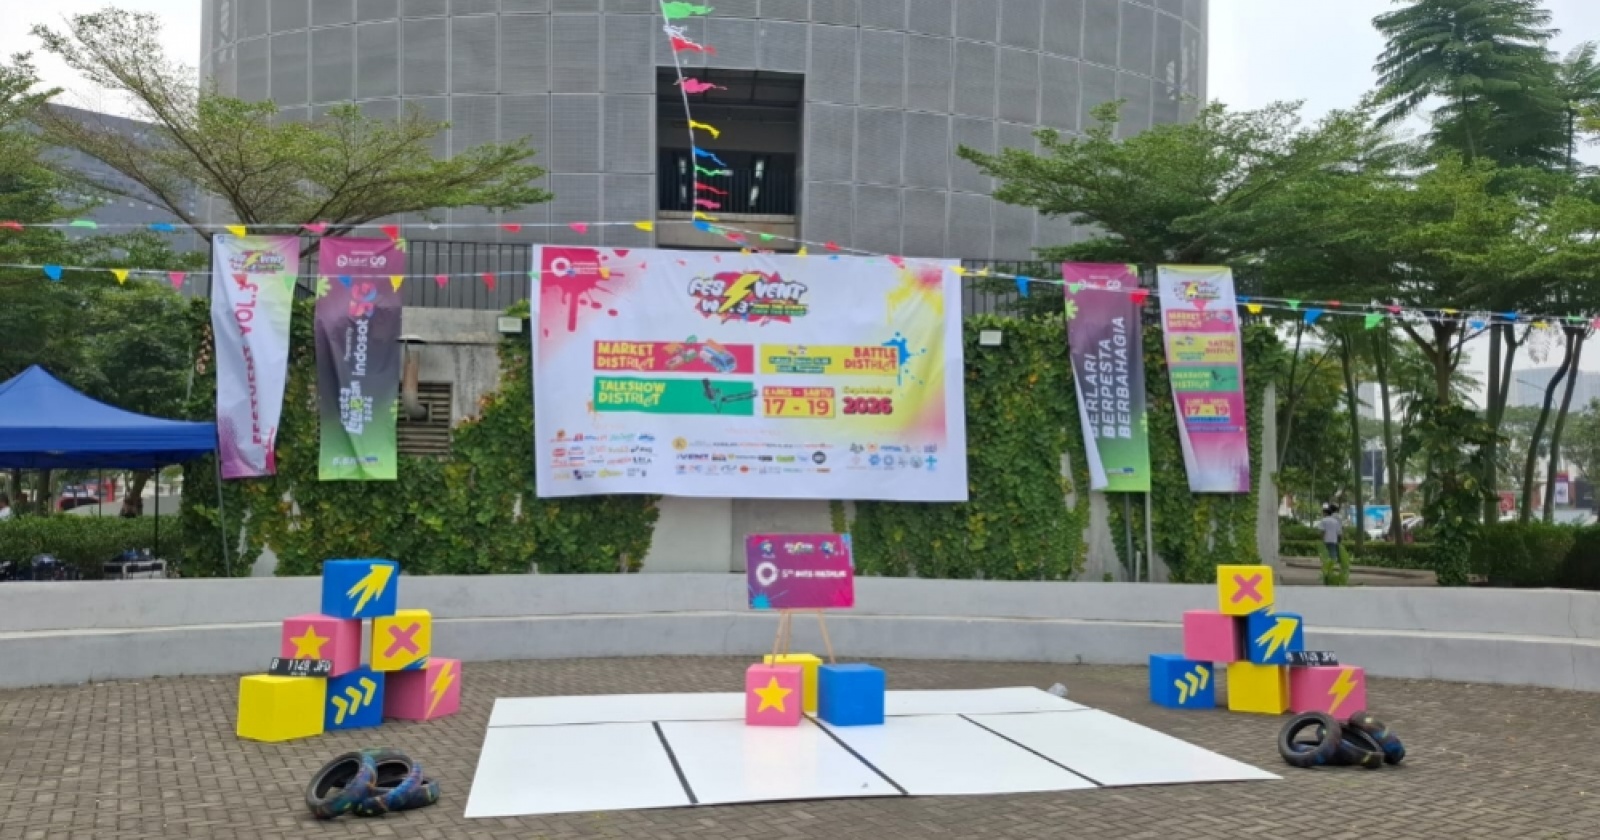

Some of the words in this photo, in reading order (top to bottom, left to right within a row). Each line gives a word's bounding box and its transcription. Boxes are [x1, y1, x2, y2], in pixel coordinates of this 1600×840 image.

[755, 279, 807, 299] VENT
[352, 319, 368, 376] Indosat
[598, 342, 654, 356] MARKET
[853, 346, 897, 359] BATTLE
[598, 356, 655, 370] DISTRICT
[843, 358, 897, 372] DISTRICT
[1112, 317, 1131, 438] BERBAHAGIA
[598, 380, 666, 393] TALKSHOW
[1099, 339, 1116, 438] BERPESTA
[598, 392, 661, 407] DISTRICT
[764, 399, 786, 415] 17
[807, 399, 830, 415] 19
[843, 396, 893, 415] 2026
